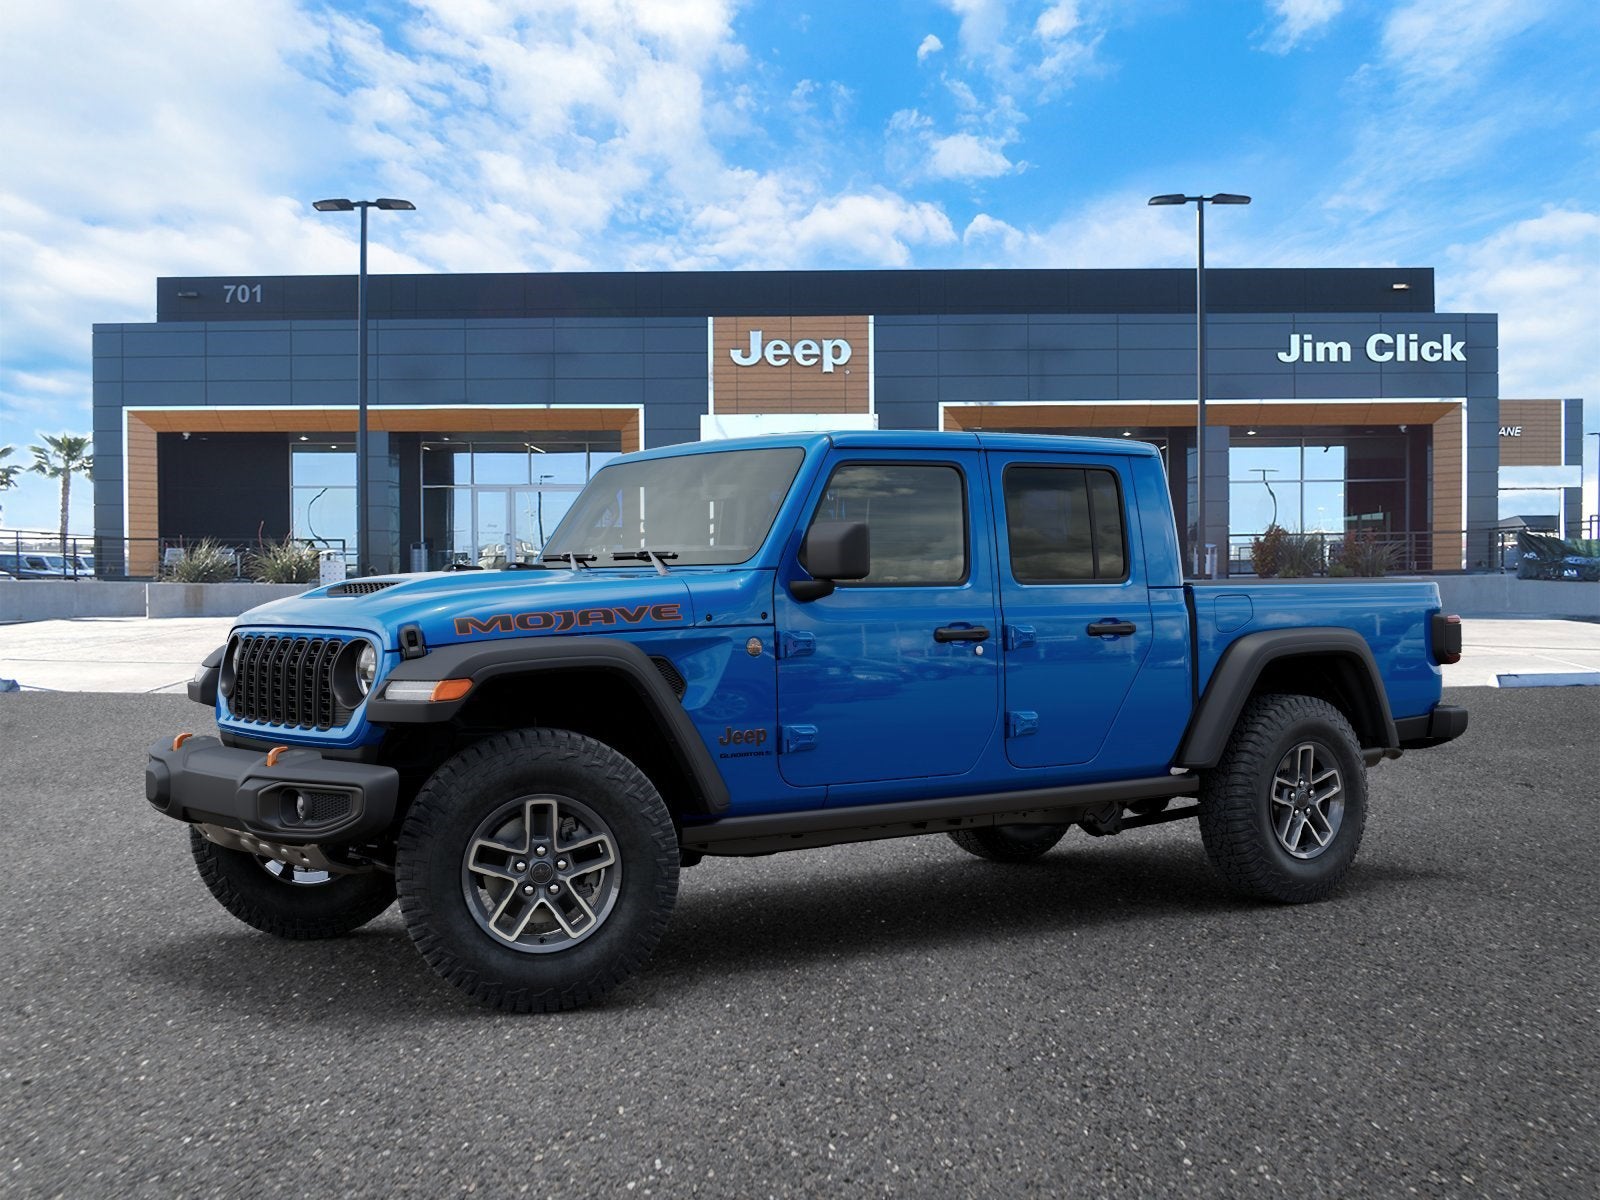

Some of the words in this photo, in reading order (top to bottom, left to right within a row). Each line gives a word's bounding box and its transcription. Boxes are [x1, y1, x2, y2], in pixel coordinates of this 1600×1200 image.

[223, 284, 261, 303] 701
[729, 330, 852, 373] Jeep
[1277, 334, 1351, 362] Jim
[1366, 333, 1467, 362] Click
[453, 604, 683, 635] MOJAVE
[718, 726, 767, 747] Jeep
